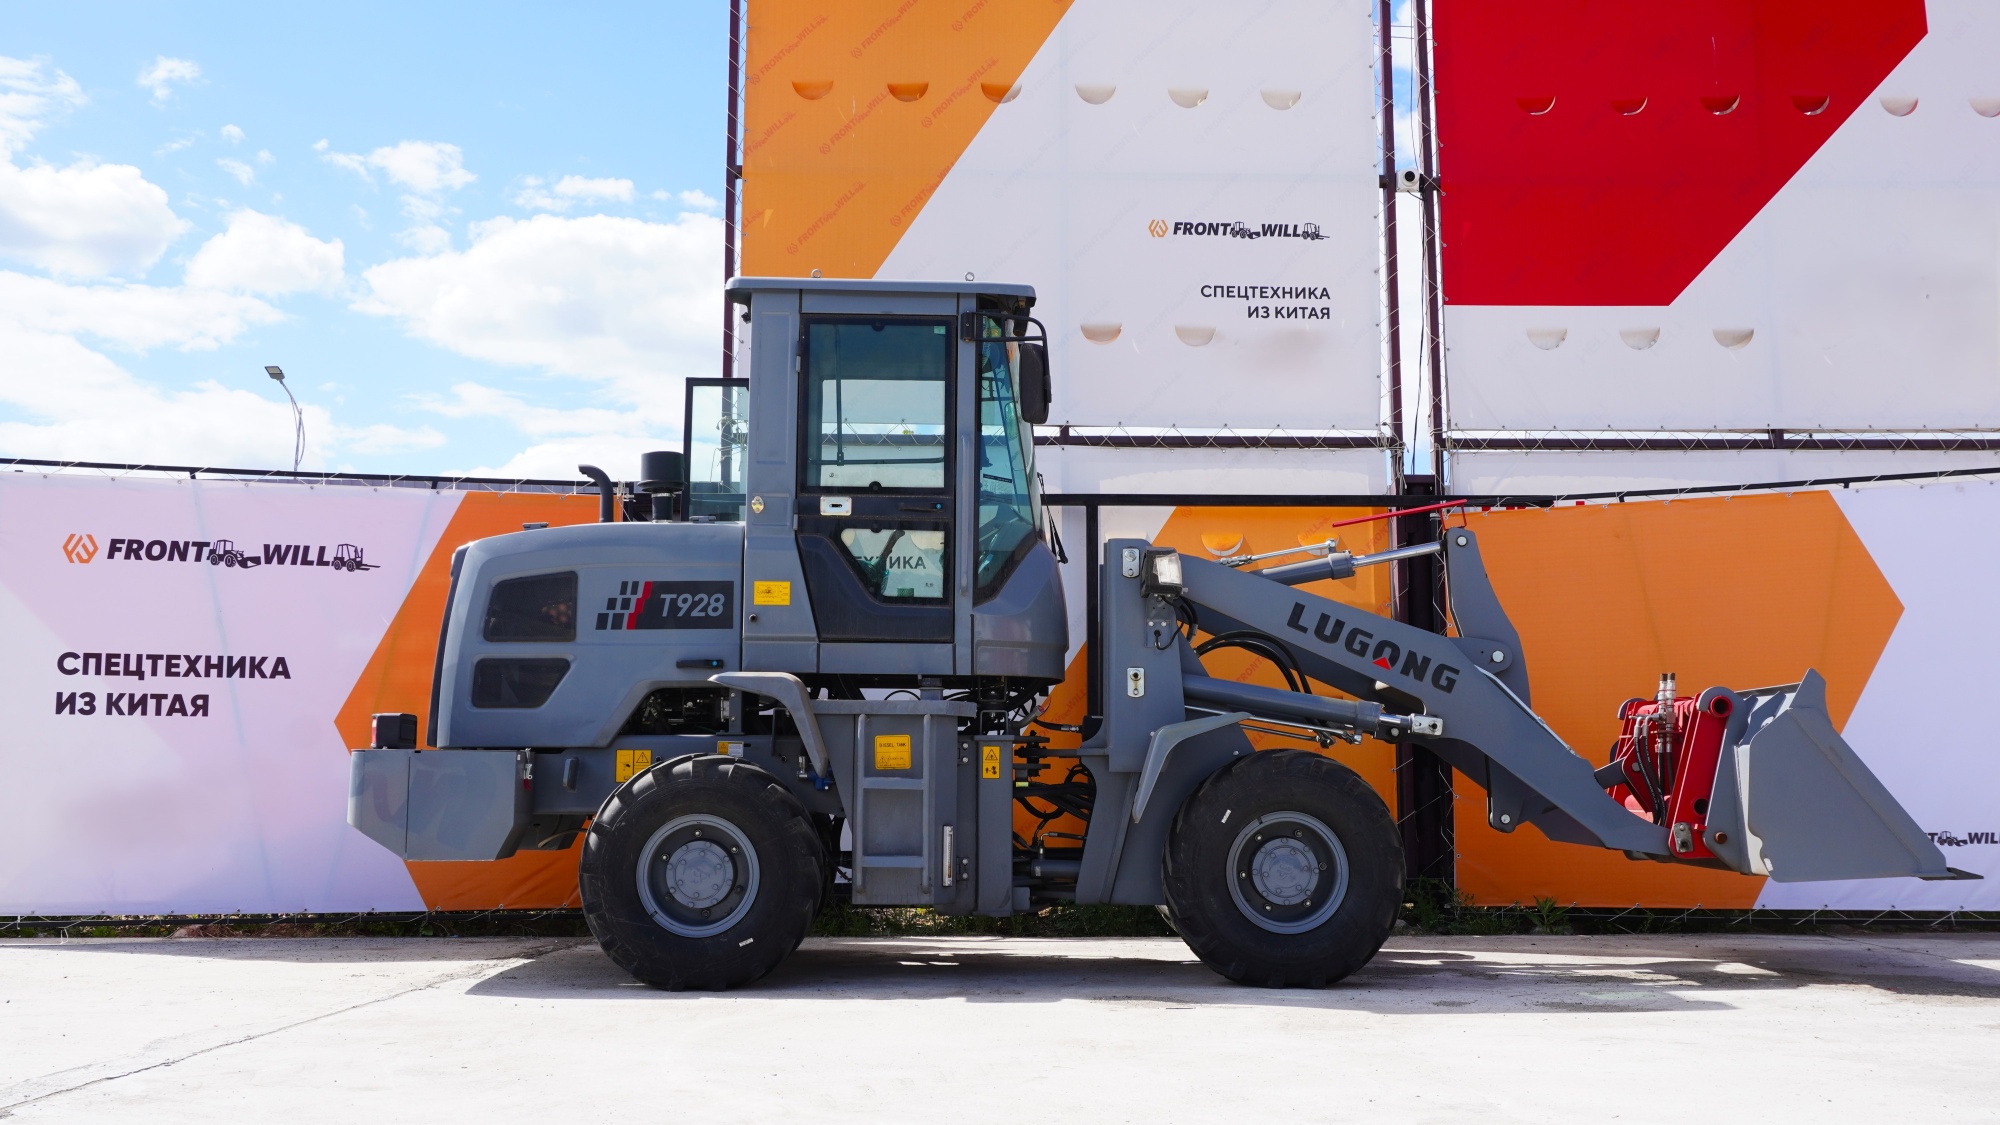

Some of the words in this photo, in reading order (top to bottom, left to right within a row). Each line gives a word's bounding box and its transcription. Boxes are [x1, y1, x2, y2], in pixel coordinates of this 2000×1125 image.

[1173, 222, 1231, 236] FRONT
[1261, 224, 1300, 237] WILL
[1200, 284, 1331, 300] СПЕЦТЕХНИКА
[1247, 306, 1270, 319] ИЗ
[1275, 306, 1331, 320] КИТАЯ
[107, 538, 210, 562] FRONT
[263, 543, 331, 567] WILL
[660, 593, 725, 617] T928
[1286, 601, 1461, 694] LUGONG
[57, 651, 291, 681] СПЕЦТЕХНИКА
[55, 692, 96, 715] ИЗ
[106, 693, 209, 717] КИТАЯ
[1967, 832, 2000, 845] WIL
